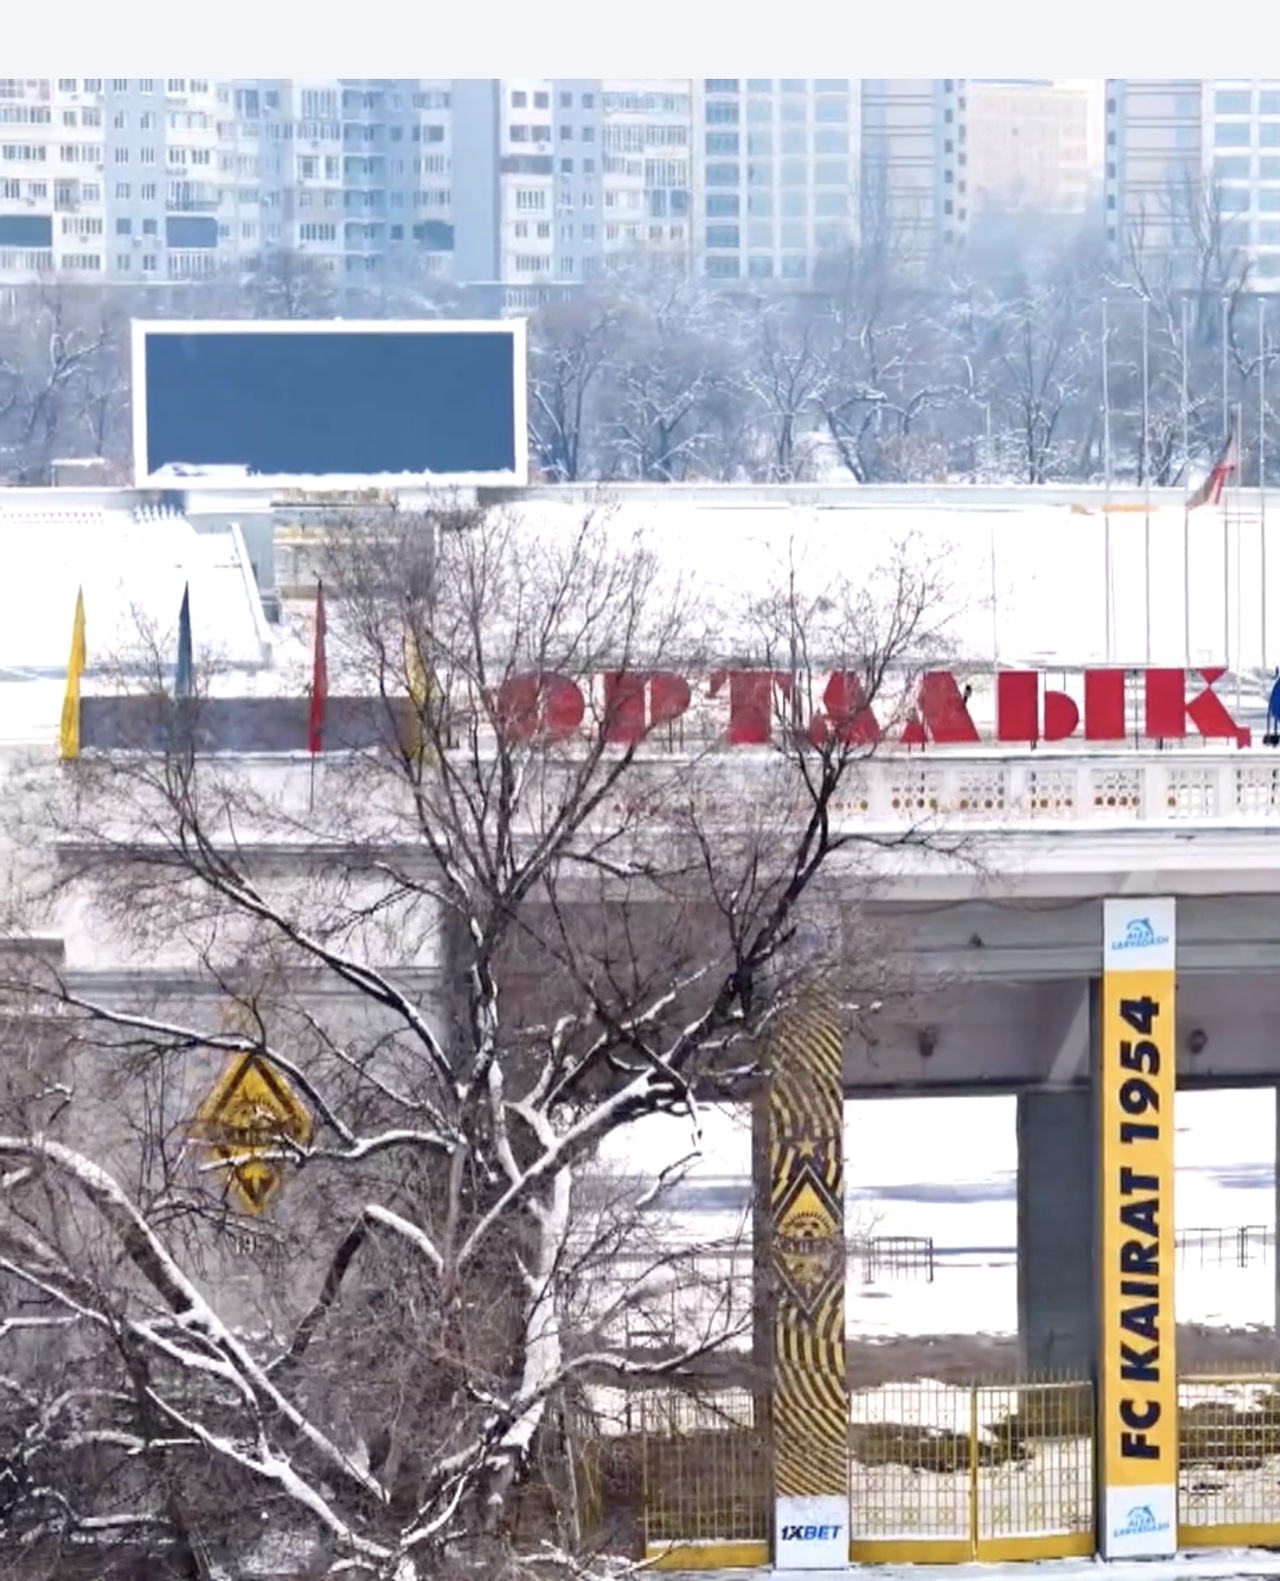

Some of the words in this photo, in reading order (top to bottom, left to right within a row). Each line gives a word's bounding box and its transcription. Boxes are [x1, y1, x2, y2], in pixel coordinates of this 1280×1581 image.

[1119, 995, 1160, 1144] 1954
[1119, 1166, 1160, 1383] KAIRAT
[1119, 1398, 1161, 1460] FC
[781, 1524, 843, 1541] 1XBET
